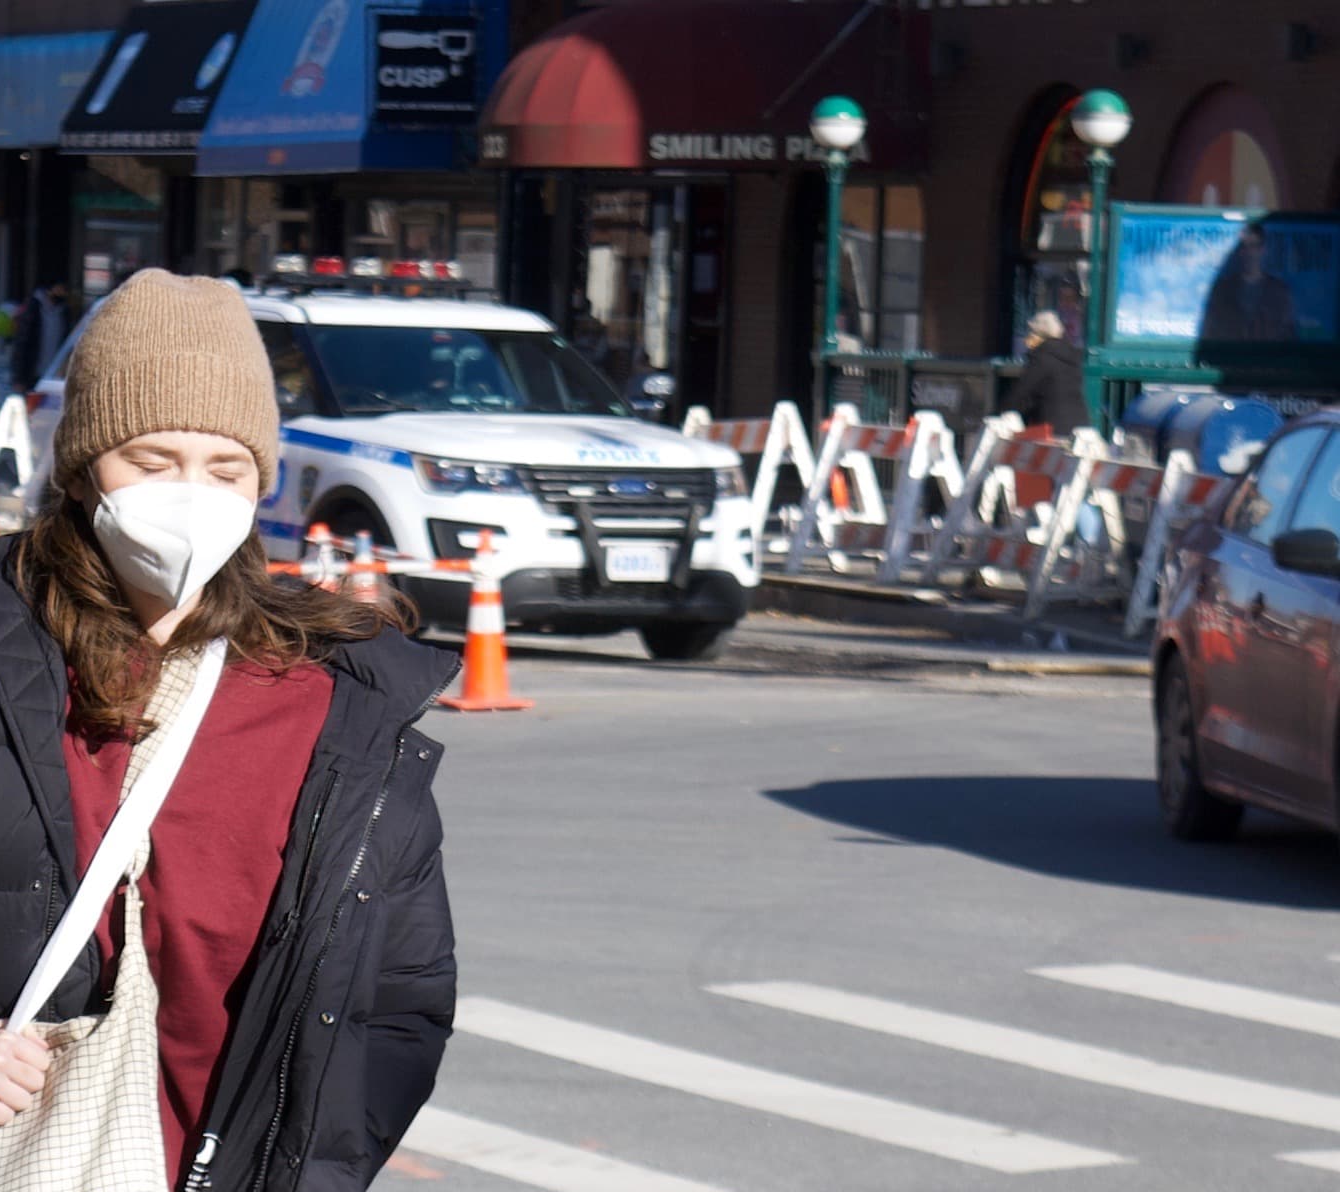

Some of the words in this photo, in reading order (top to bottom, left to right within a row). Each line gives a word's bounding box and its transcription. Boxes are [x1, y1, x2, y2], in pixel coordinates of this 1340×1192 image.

[378, 66, 446, 88] CUSP
[649, 134, 774, 161] SMILING
[785, 136, 872, 163] PIA
[577, 449, 661, 464] POLICE
